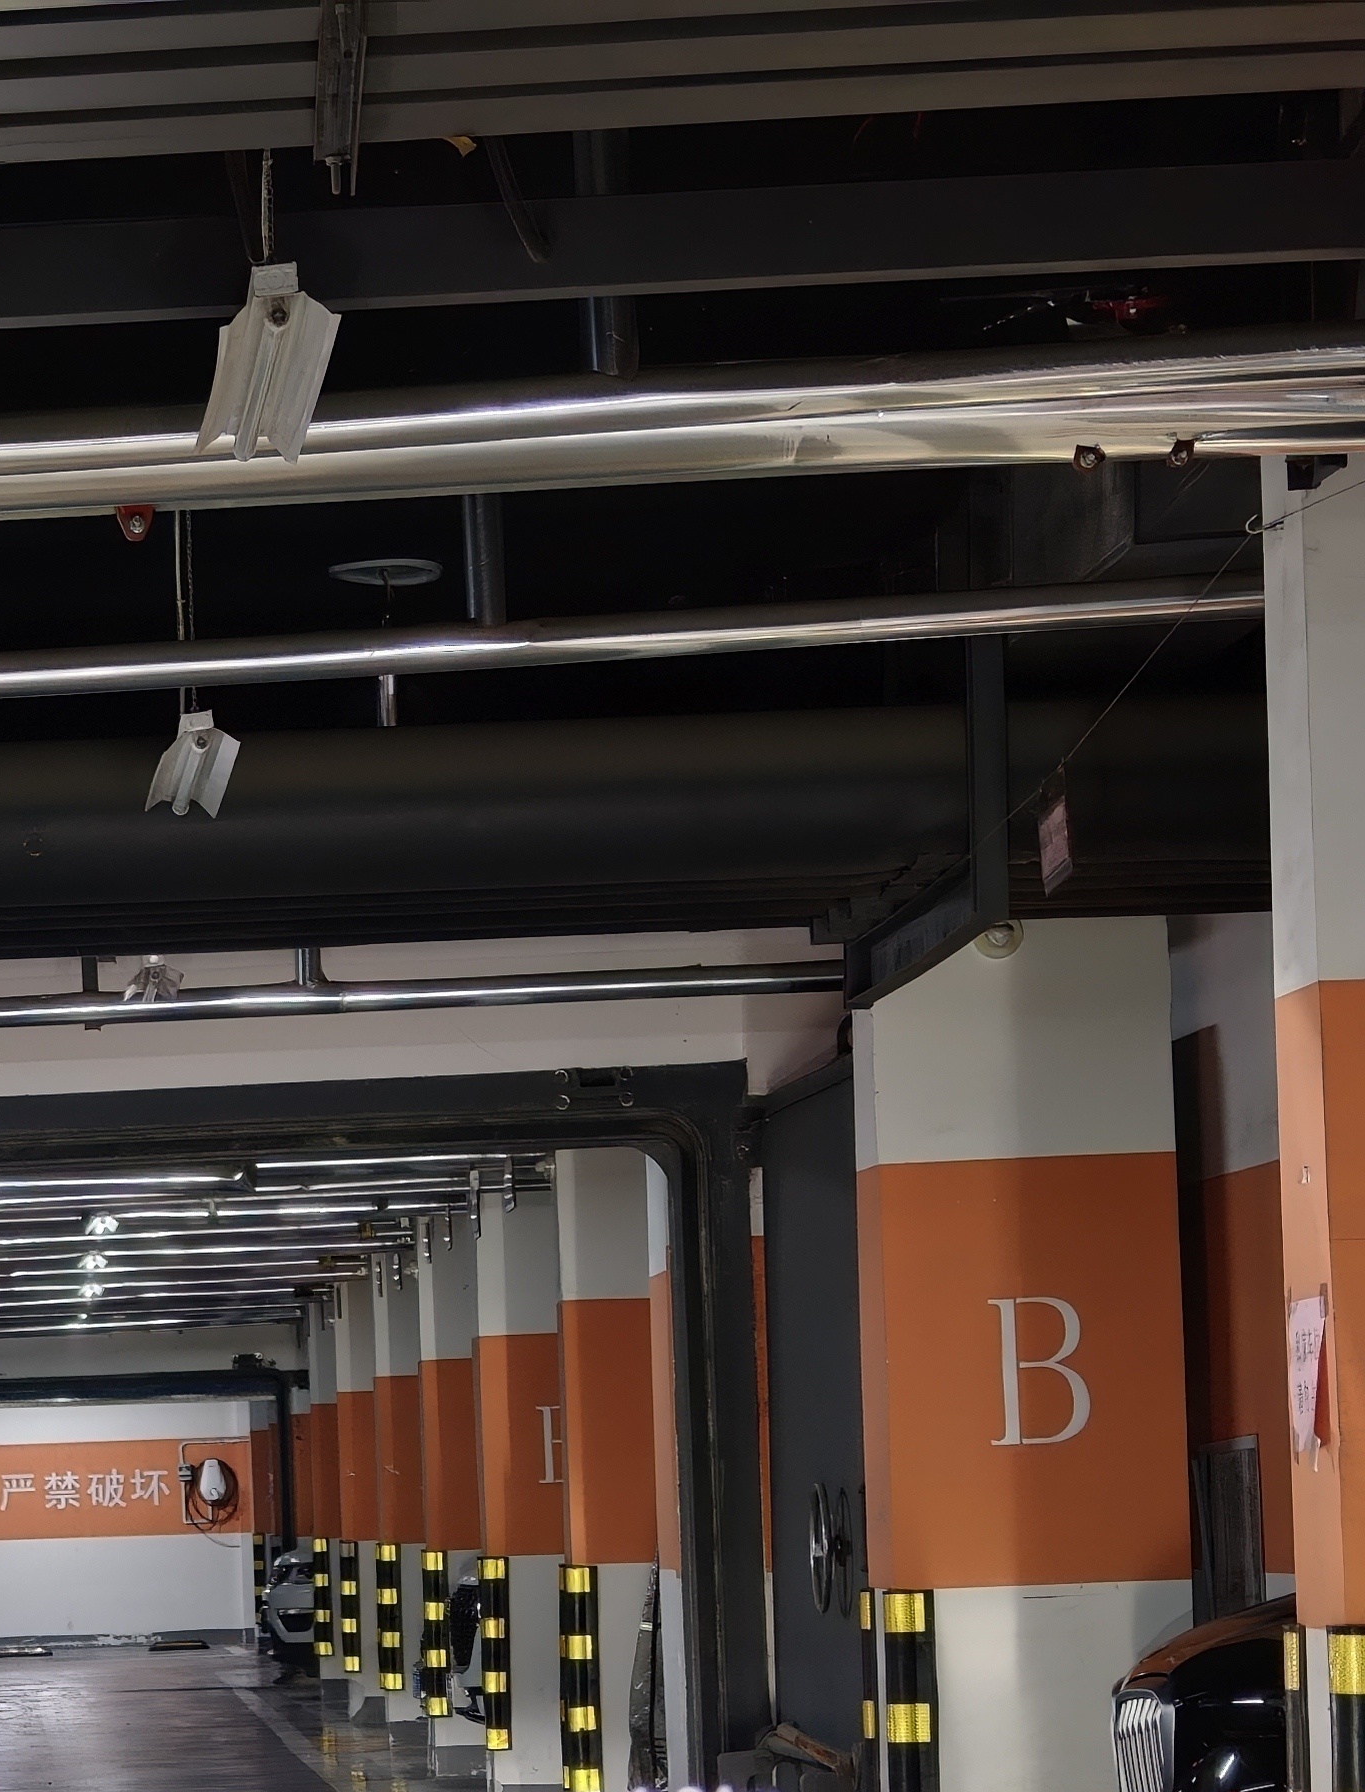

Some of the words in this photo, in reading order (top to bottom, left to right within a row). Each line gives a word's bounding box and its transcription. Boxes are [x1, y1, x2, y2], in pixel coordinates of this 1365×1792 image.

[987, 1296, 1091, 1446] B
[0, 1468, 171, 1512] 严禁破坏
